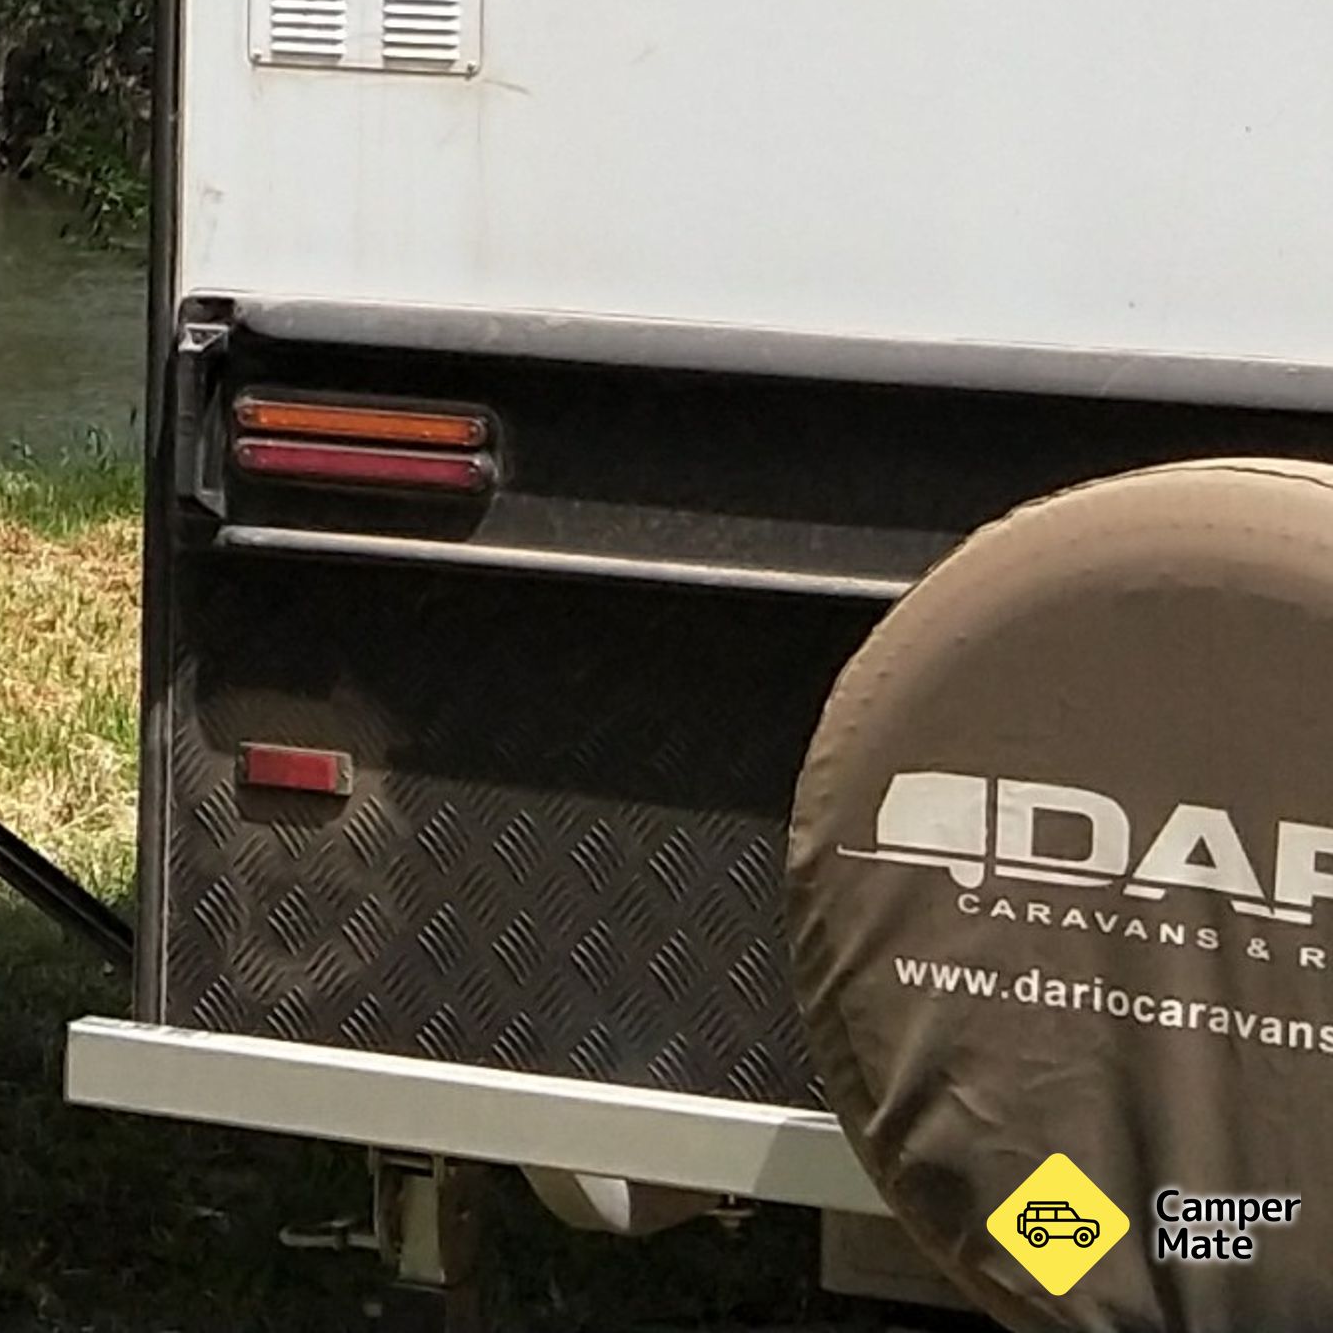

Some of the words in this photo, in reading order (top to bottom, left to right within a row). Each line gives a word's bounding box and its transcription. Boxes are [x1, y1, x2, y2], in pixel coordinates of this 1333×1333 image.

[957, 893, 1219, 950] CARAVANS
[1246, 937, 1270, 961] &
[894, 957, 1333, 1053] www.dariocaravans
